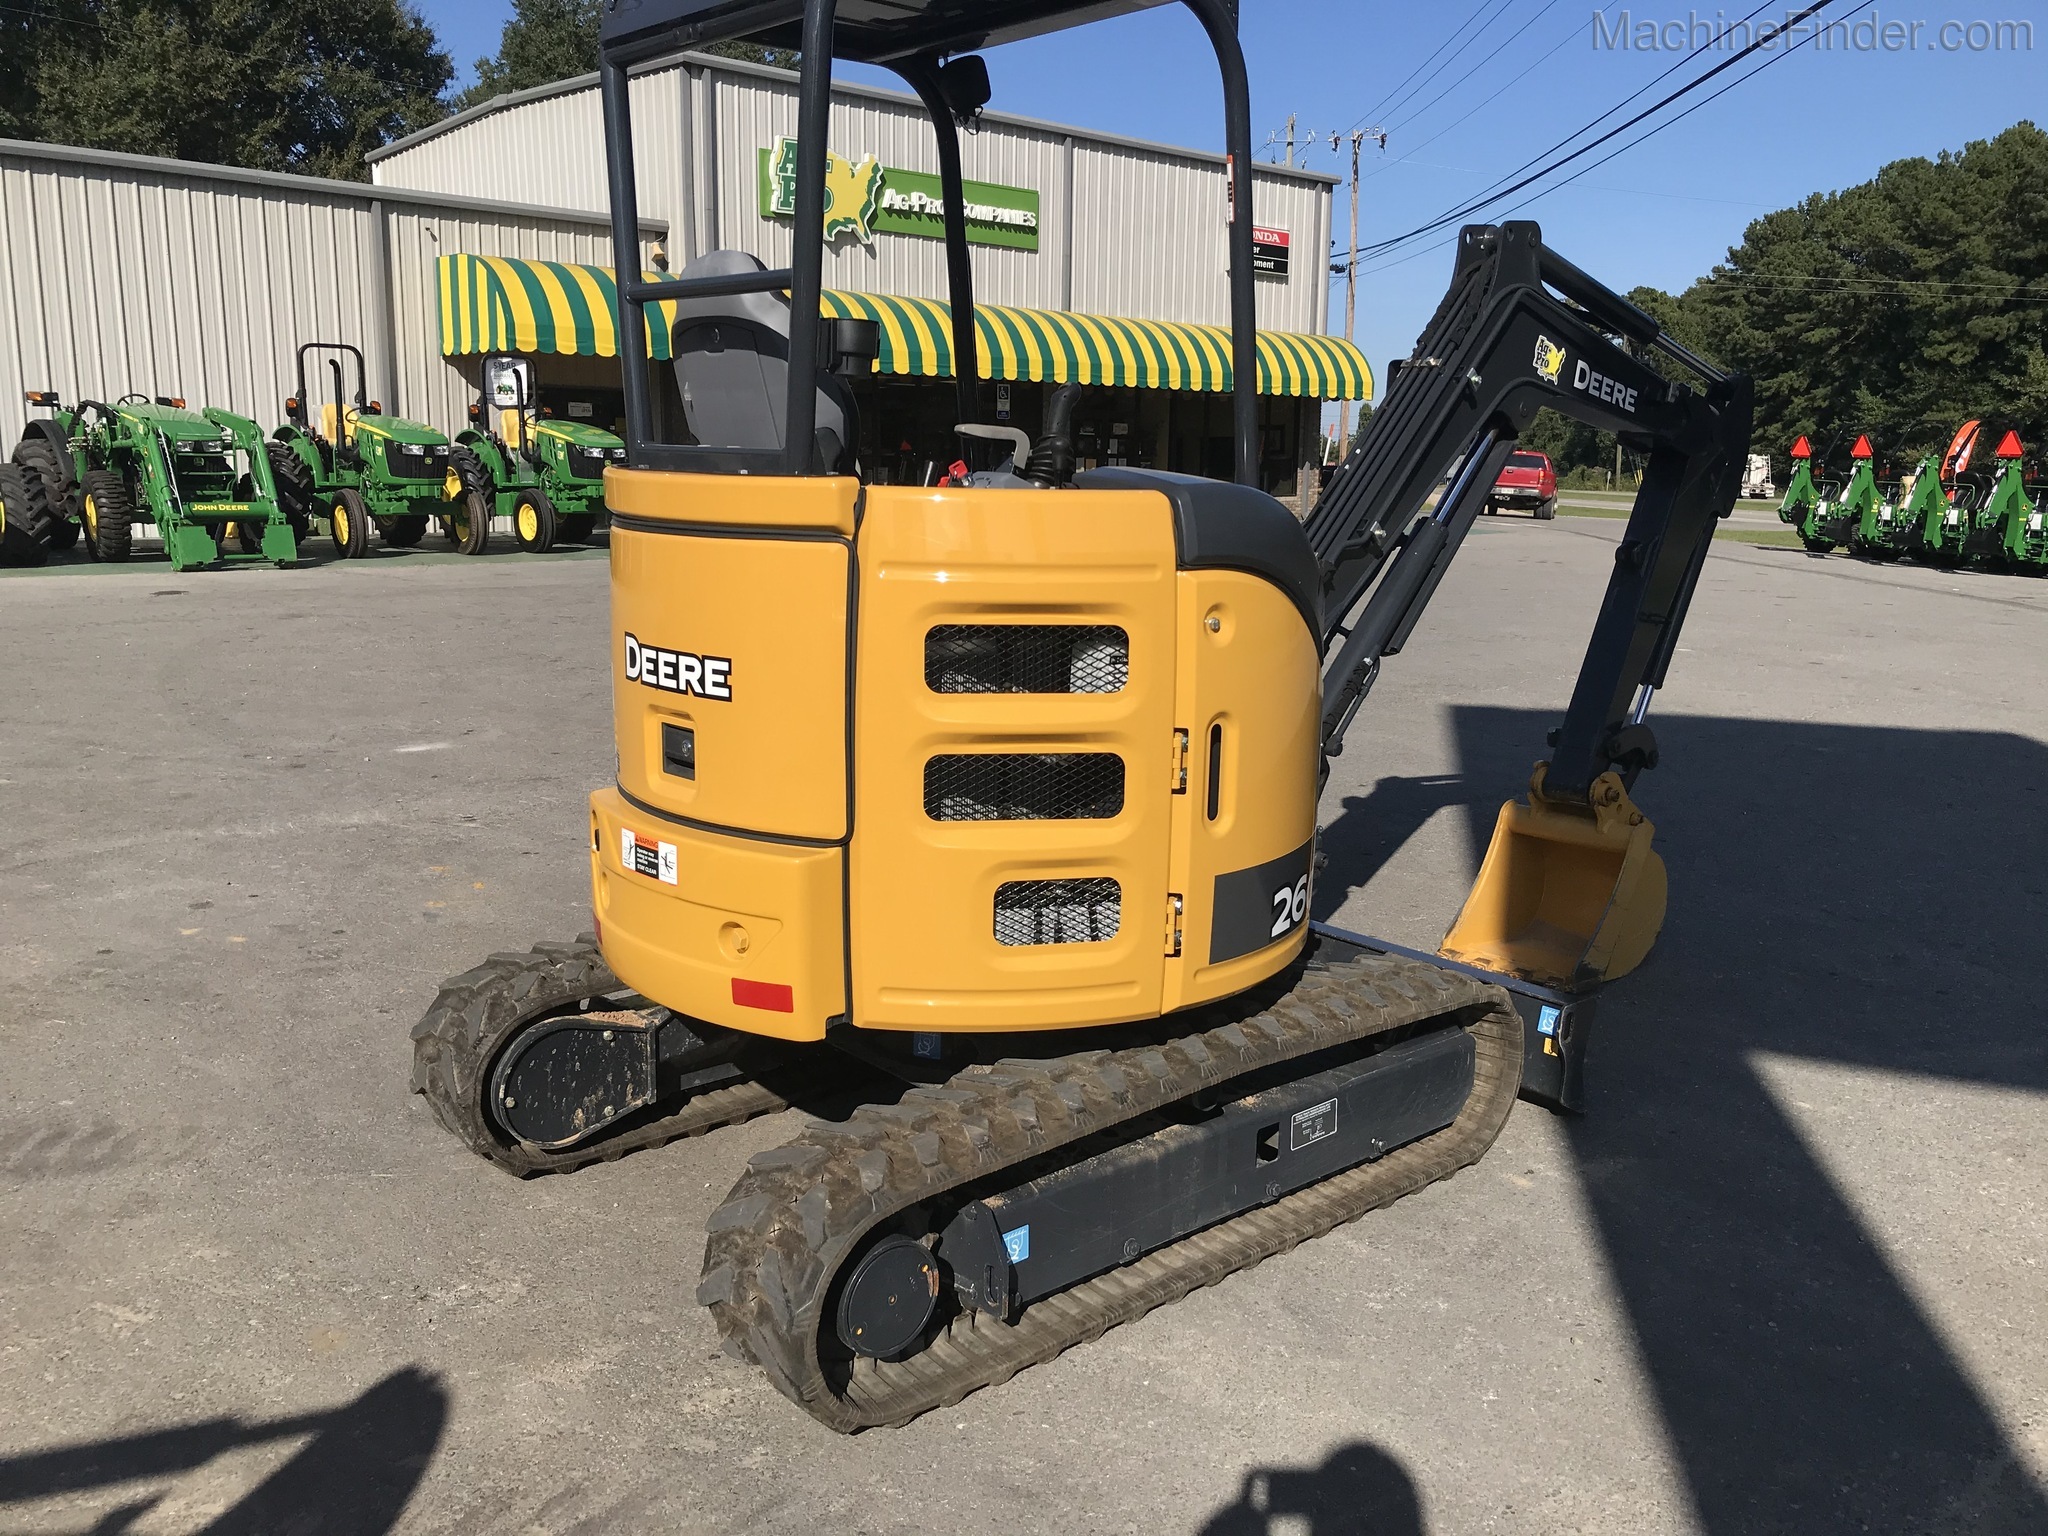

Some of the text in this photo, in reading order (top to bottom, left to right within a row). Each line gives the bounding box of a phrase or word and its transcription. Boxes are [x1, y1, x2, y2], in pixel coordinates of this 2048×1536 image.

[1252, 230, 1281, 243] NDA
[1573, 359, 1638, 414] DEERE
[192, 503, 250, 511] JOHN DEERE
[625, 633, 731, 700] DEERE
[1271, 873, 1308, 938] 26
